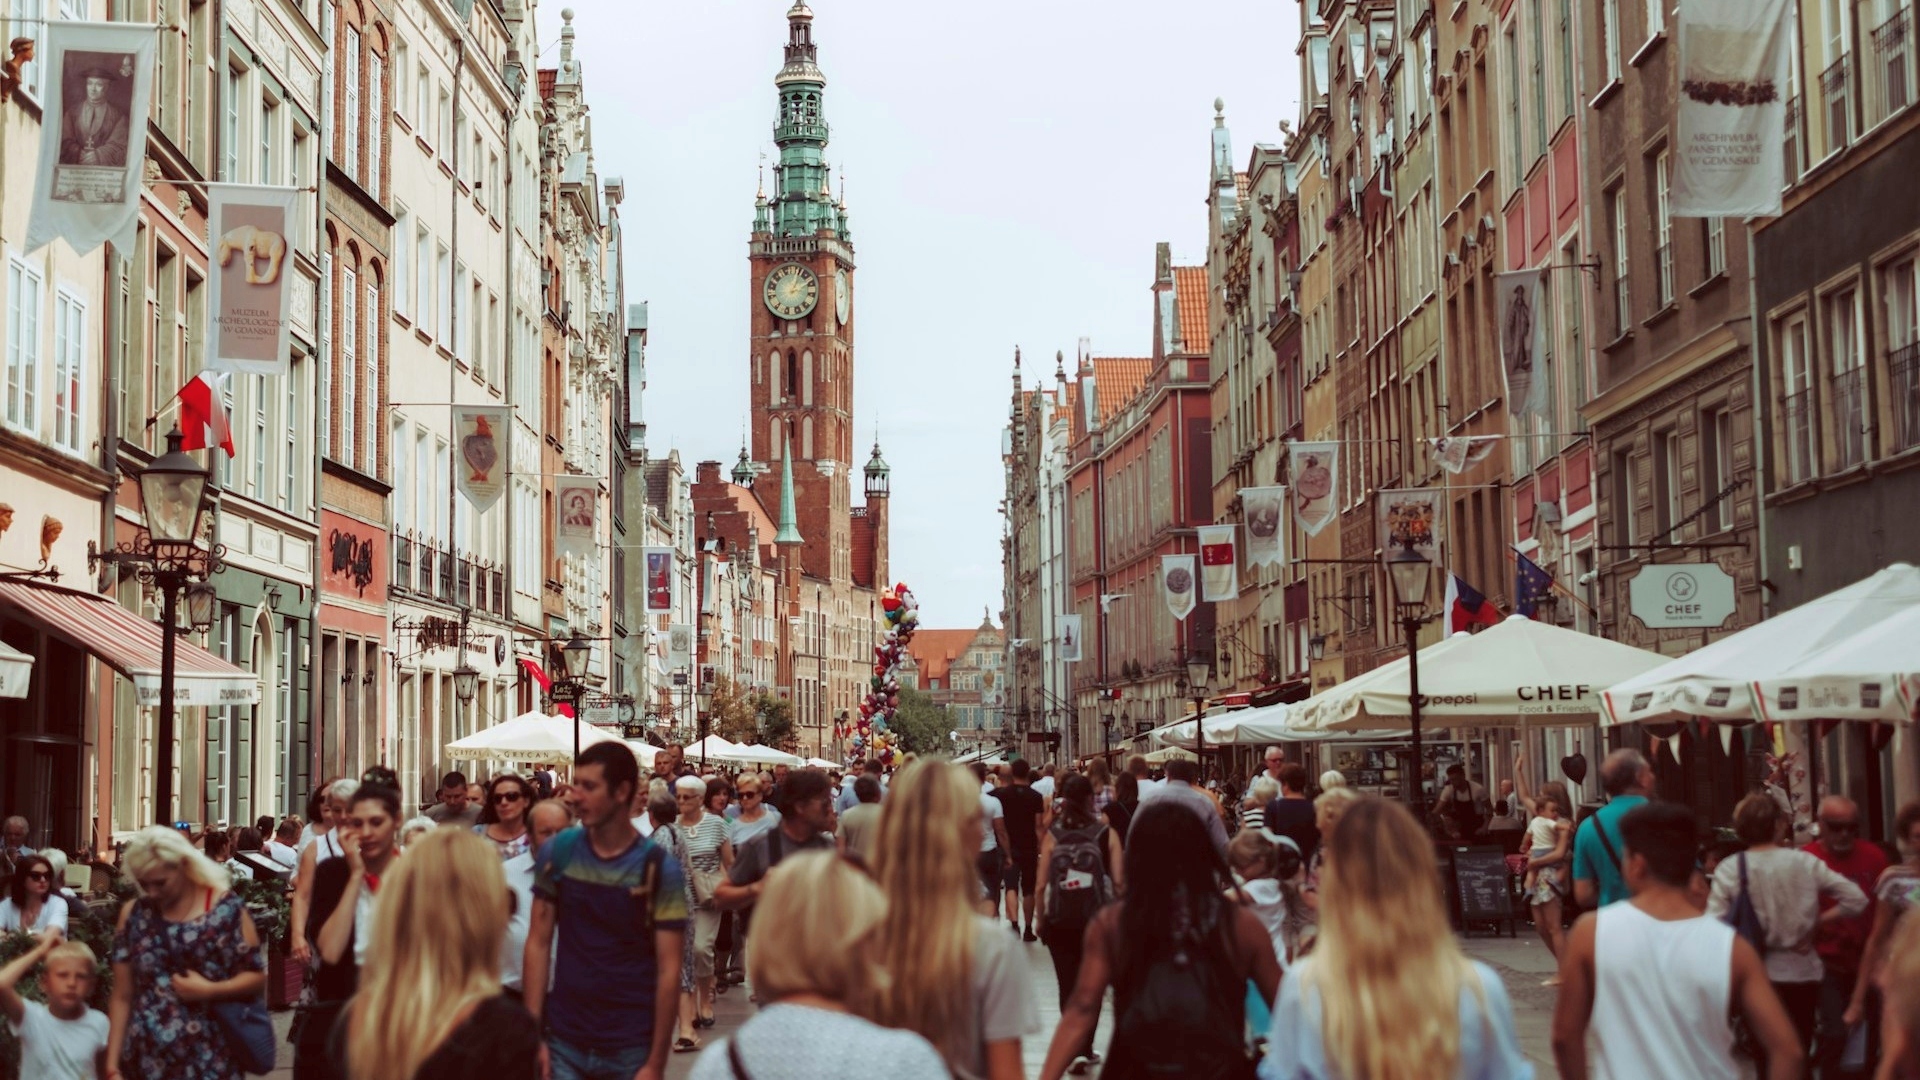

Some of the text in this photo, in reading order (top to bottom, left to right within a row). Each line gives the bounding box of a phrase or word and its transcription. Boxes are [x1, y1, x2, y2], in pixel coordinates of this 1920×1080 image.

[231, 308, 270, 317] MUZEUM
[213, 316, 285, 327] ARCHEOLOGICZNE
[223, 326, 233, 334] W
[1665, 604, 1702, 614] CHEF
[1517, 684, 1590, 701] CHEF
[1432, 693, 1478, 707] pepsi
[1518, 704, 1592, 713] Food & Friends
